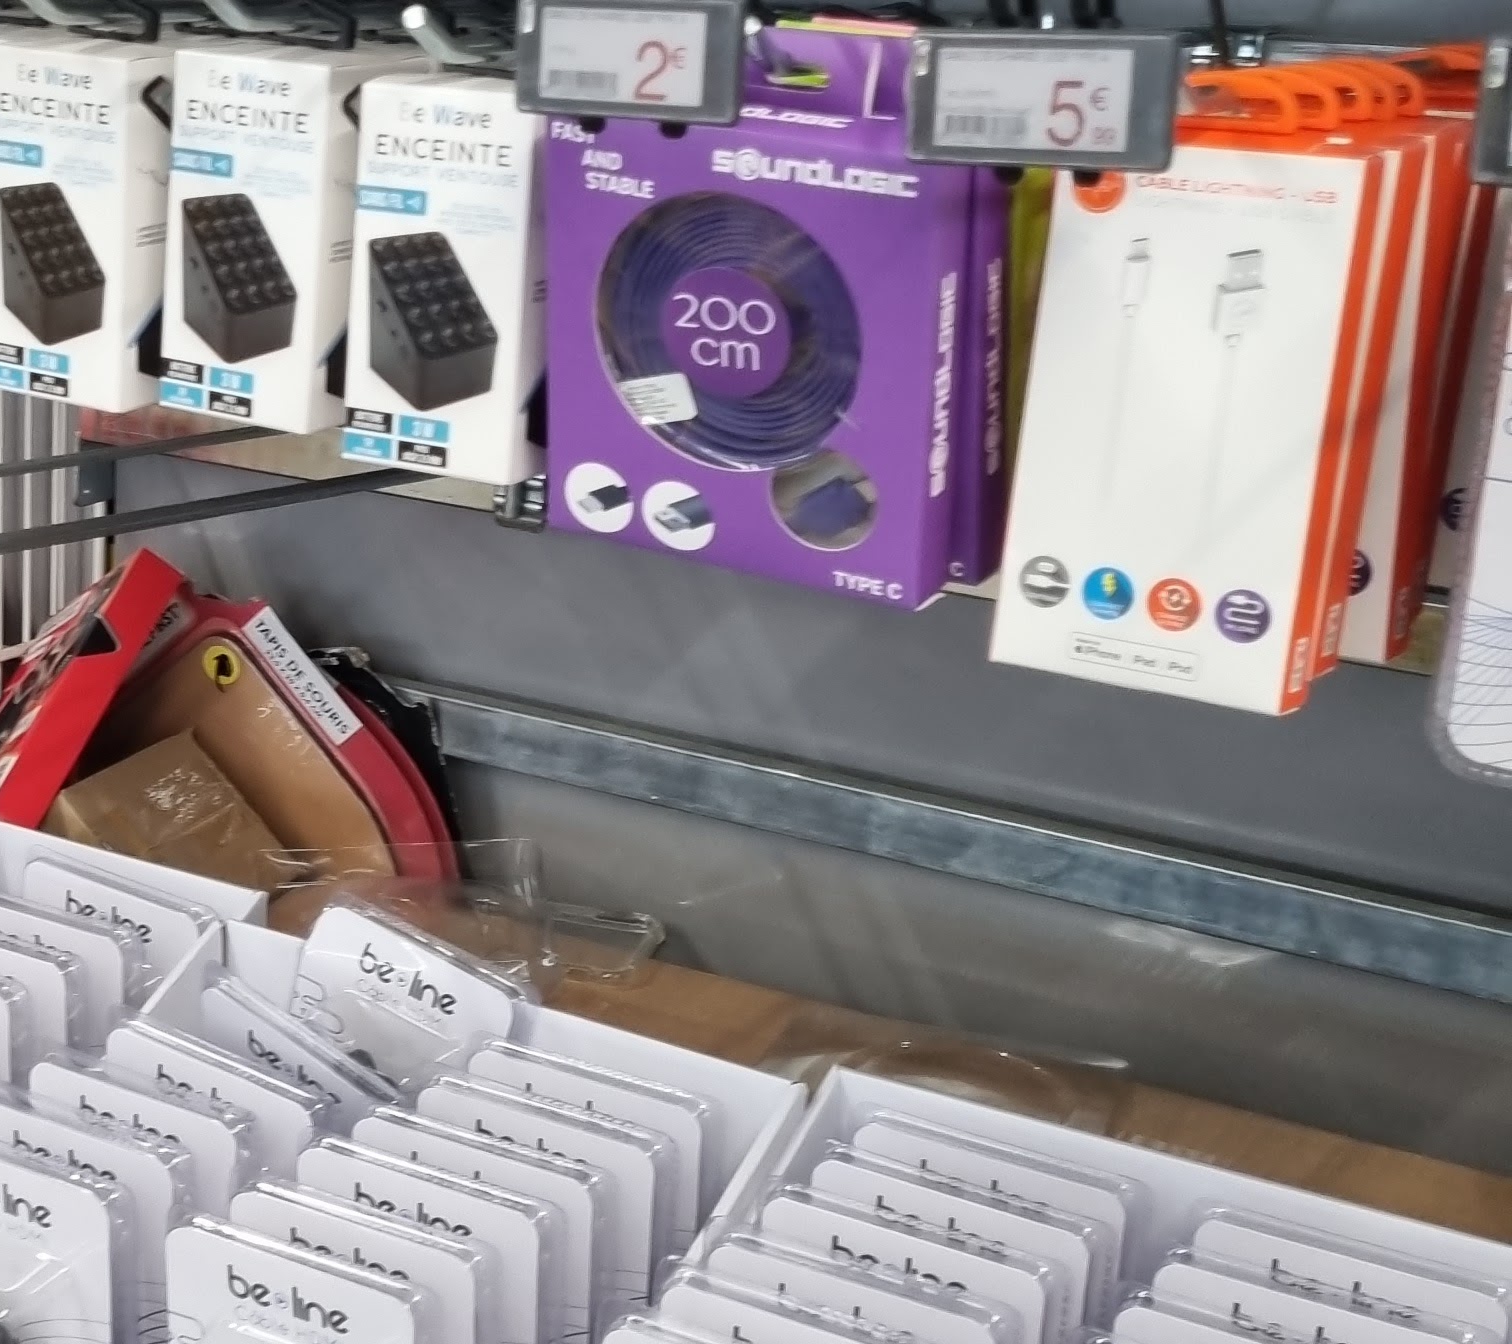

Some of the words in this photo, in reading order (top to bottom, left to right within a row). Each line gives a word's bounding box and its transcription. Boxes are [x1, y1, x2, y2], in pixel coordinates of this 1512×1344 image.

[187, 99, 310, 134] ENCEINTE
[376, 134, 513, 168] ENCEINTE
[581, 149, 623, 171] AND
[584, 172, 656, 199] STABLE
[672, 293, 777, 338] 200
[690, 336, 762, 372] cm
[832, 570, 886, 598] TYPE
[886, 578, 904, 601] C
[255, 620, 289, 658] TAPIS
[285, 660, 307, 681] DE
[305, 682, 350, 735] SOURIS
